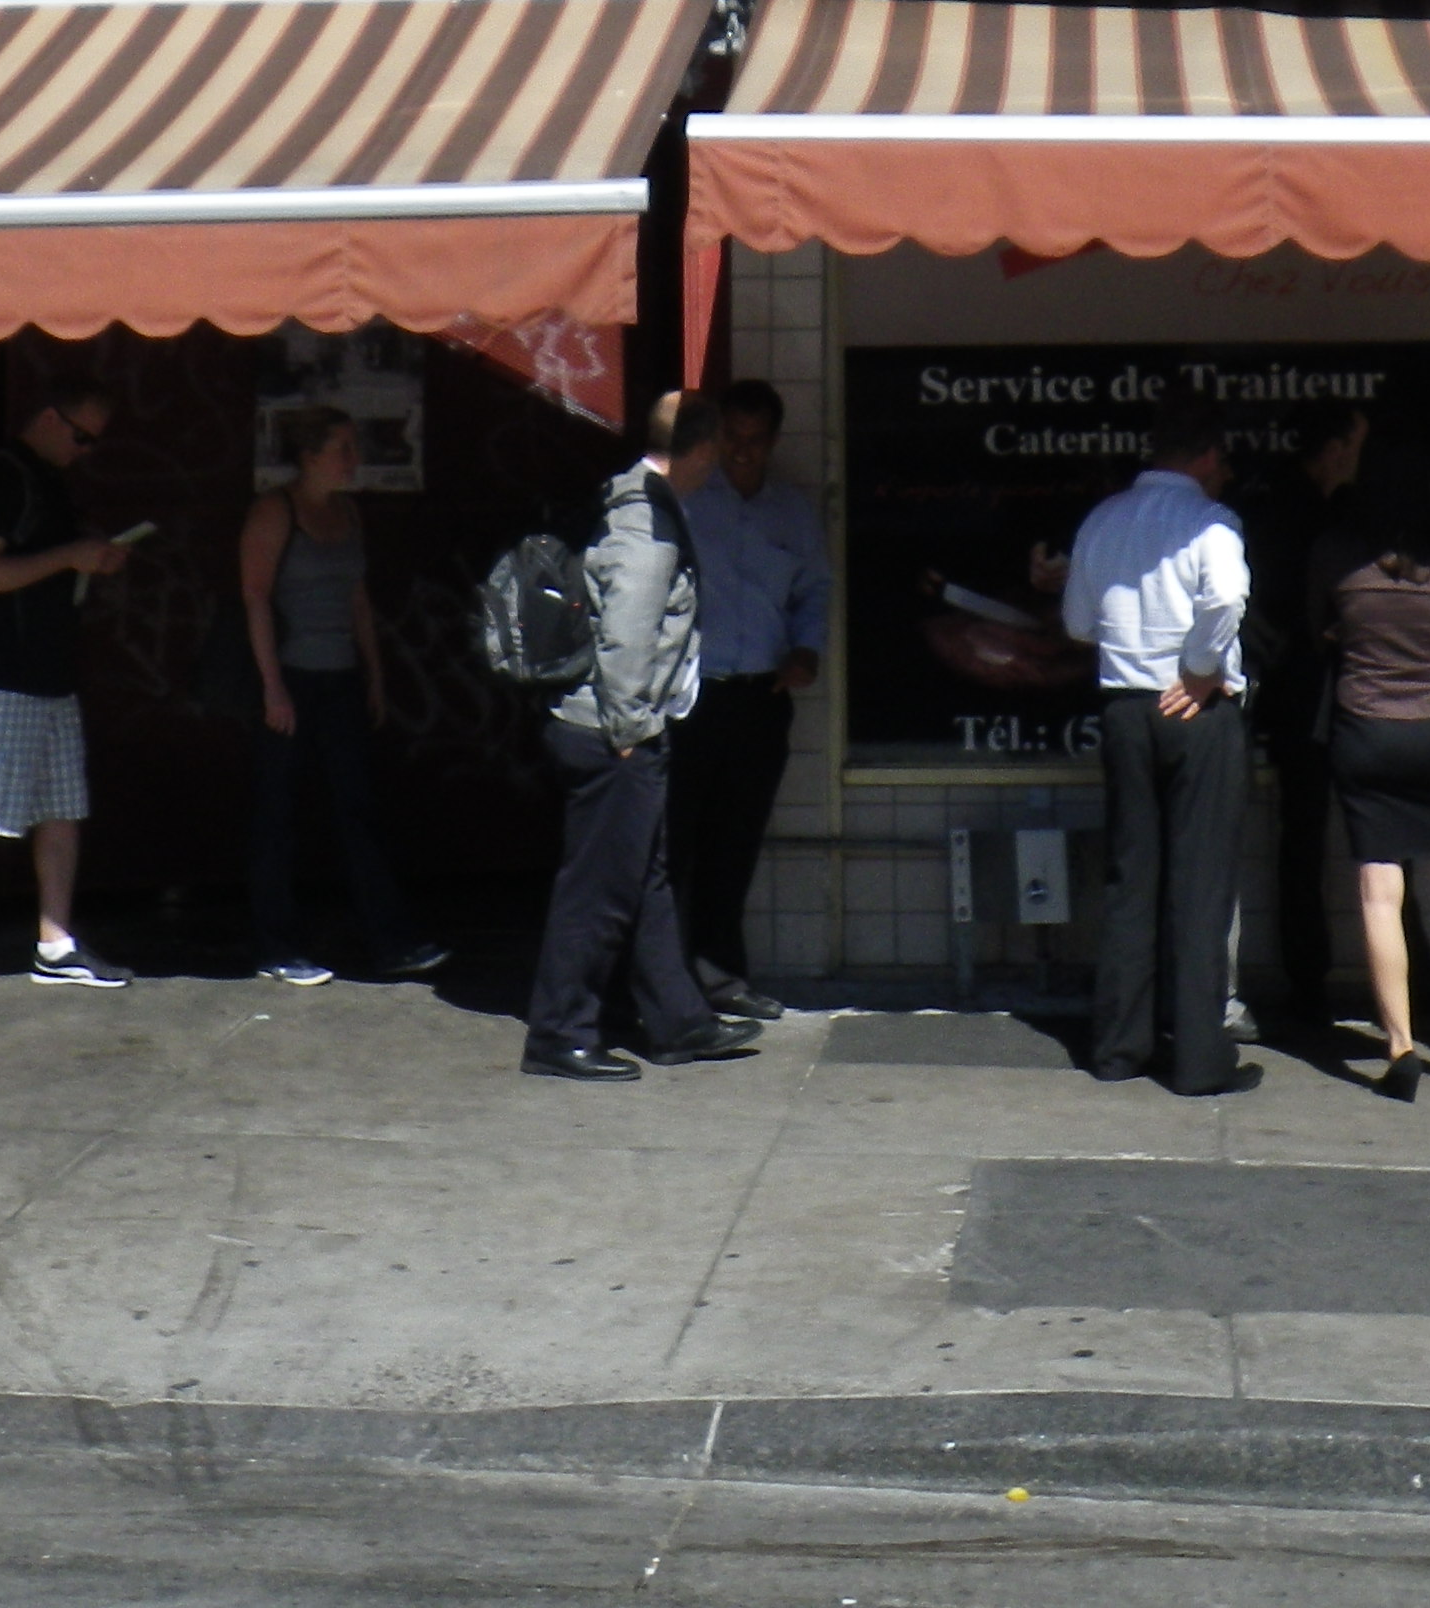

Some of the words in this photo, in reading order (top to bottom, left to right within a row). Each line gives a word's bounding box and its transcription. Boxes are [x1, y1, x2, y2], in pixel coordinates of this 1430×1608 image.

[918, 365, 1095, 404] Service
[1110, 365, 1166, 403] de
[1179, 362, 1386, 401] Traiteur
[954, 713, 1047, 752] Tél.:
